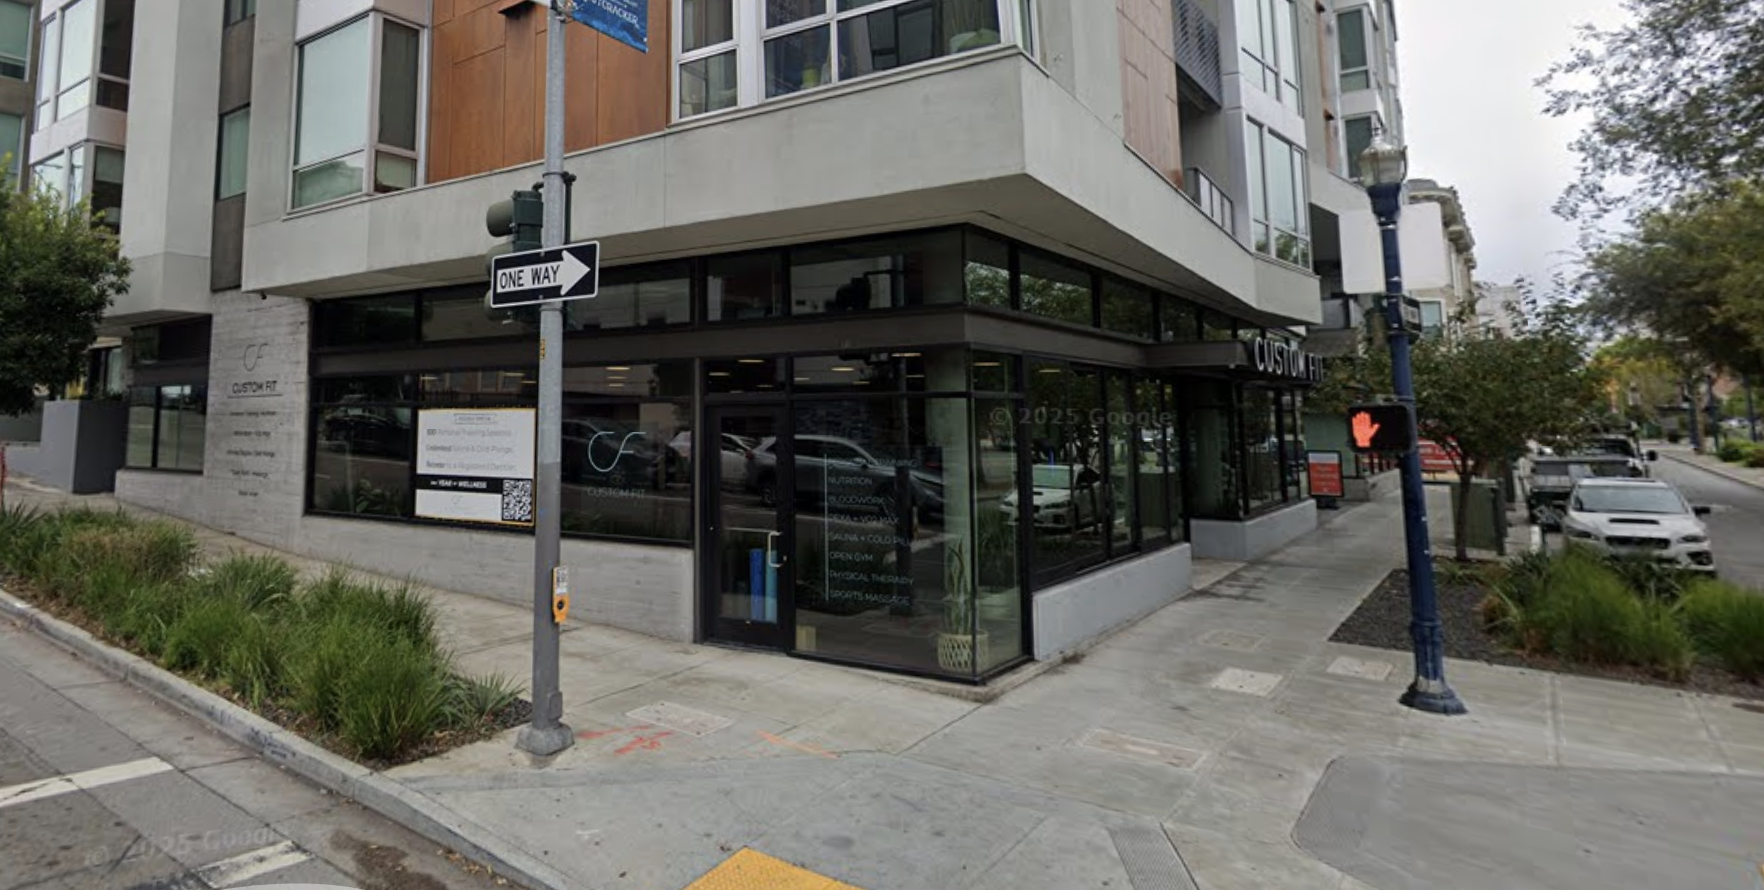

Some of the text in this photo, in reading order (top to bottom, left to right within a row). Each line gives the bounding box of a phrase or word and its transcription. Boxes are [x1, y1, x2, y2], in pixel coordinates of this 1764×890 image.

[499, 264, 561, 289] ONE WAY
[1254, 336, 1307, 379] CUSTOM
[232, 380, 278, 394] CUSTOM FIT
[828, 476, 873, 485] NUTRITION
[587, 487, 645, 499] CUSTOM FIT
[828, 495, 885, 504] BLOODWORK
[829, 533, 859, 542] SAUNA
[867, 535, 890, 544] COLD
[829, 552, 873, 562] OPEN GYM
[829, 569, 915, 585] PHYSICAL THERAPY
[829, 590, 910, 606] SPORTS MASSAGE
